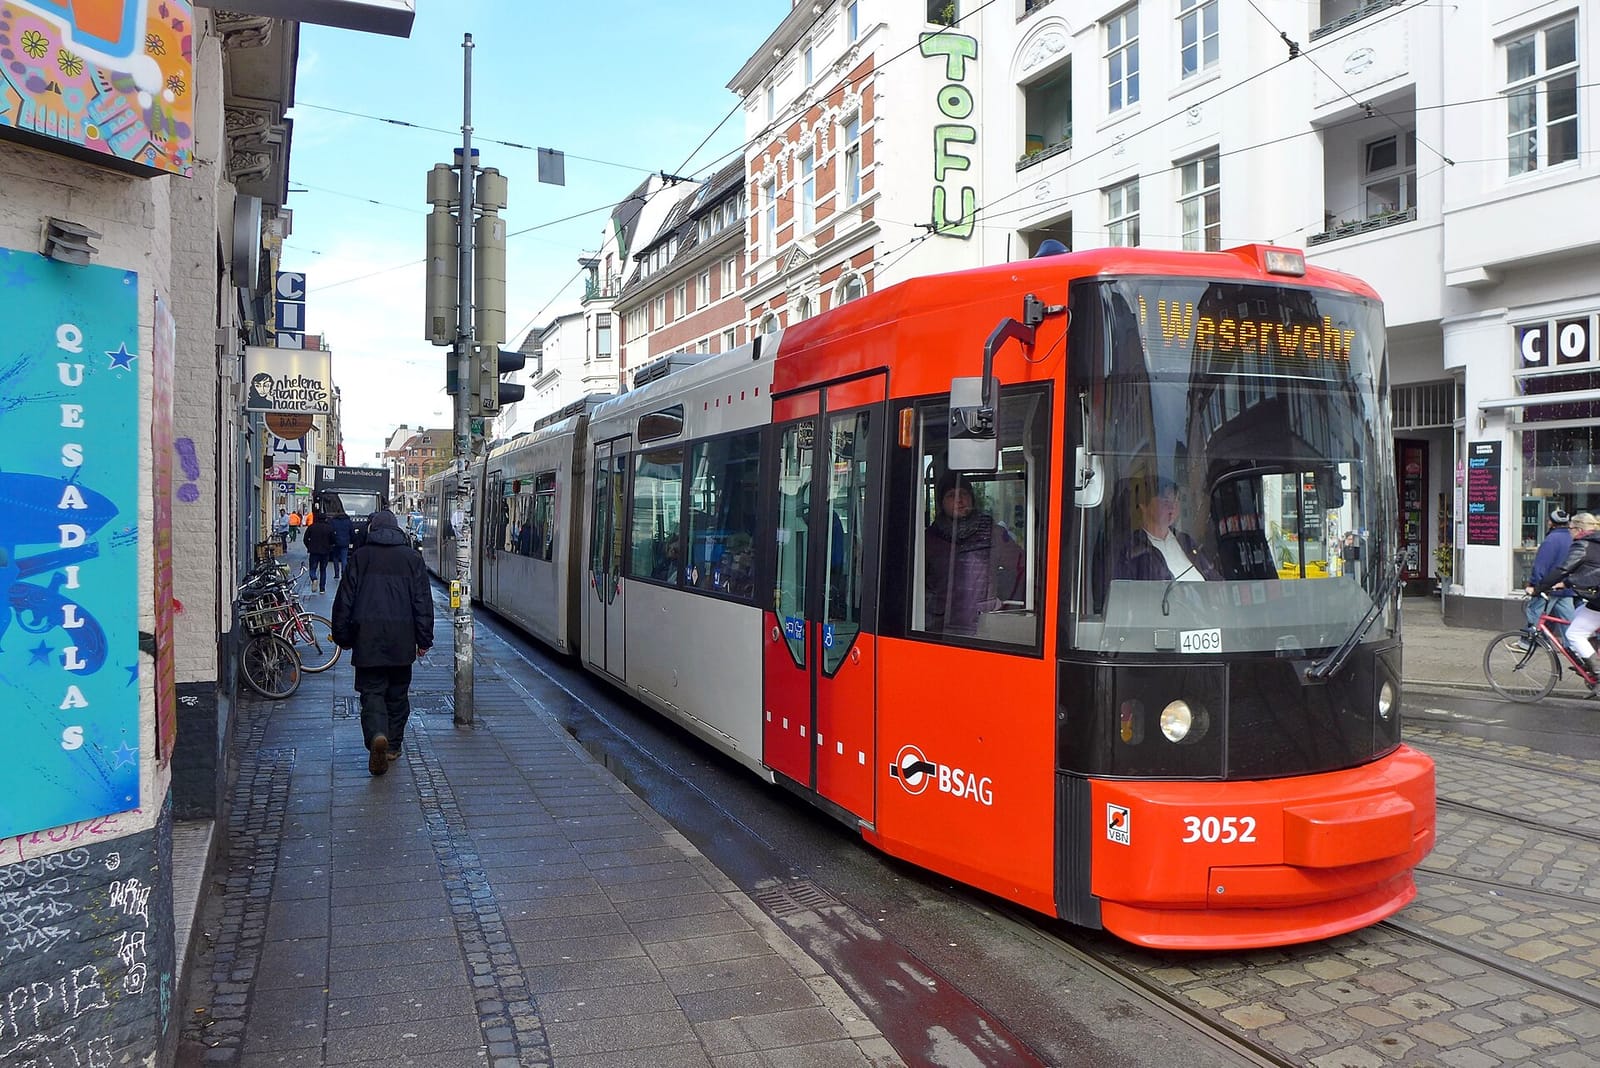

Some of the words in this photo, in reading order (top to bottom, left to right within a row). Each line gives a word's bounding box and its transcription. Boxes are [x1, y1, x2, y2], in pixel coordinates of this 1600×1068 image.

[919, 32, 978, 240] TOFU
[1158, 299, 1355, 361] Weserwehr
[273, 380, 327, 401] francisco
[282, 374, 325, 391] helena
[272, 396, 307, 410] haare
[316, 401, 329, 412] so
[56, 323, 88, 751] QUESADILLAS
[1183, 631, 1220, 650] 4069
[938, 765, 993, 806] BSAG
[1108, 830, 1129, 845] VBN
[1182, 815, 1257, 844] 3052
